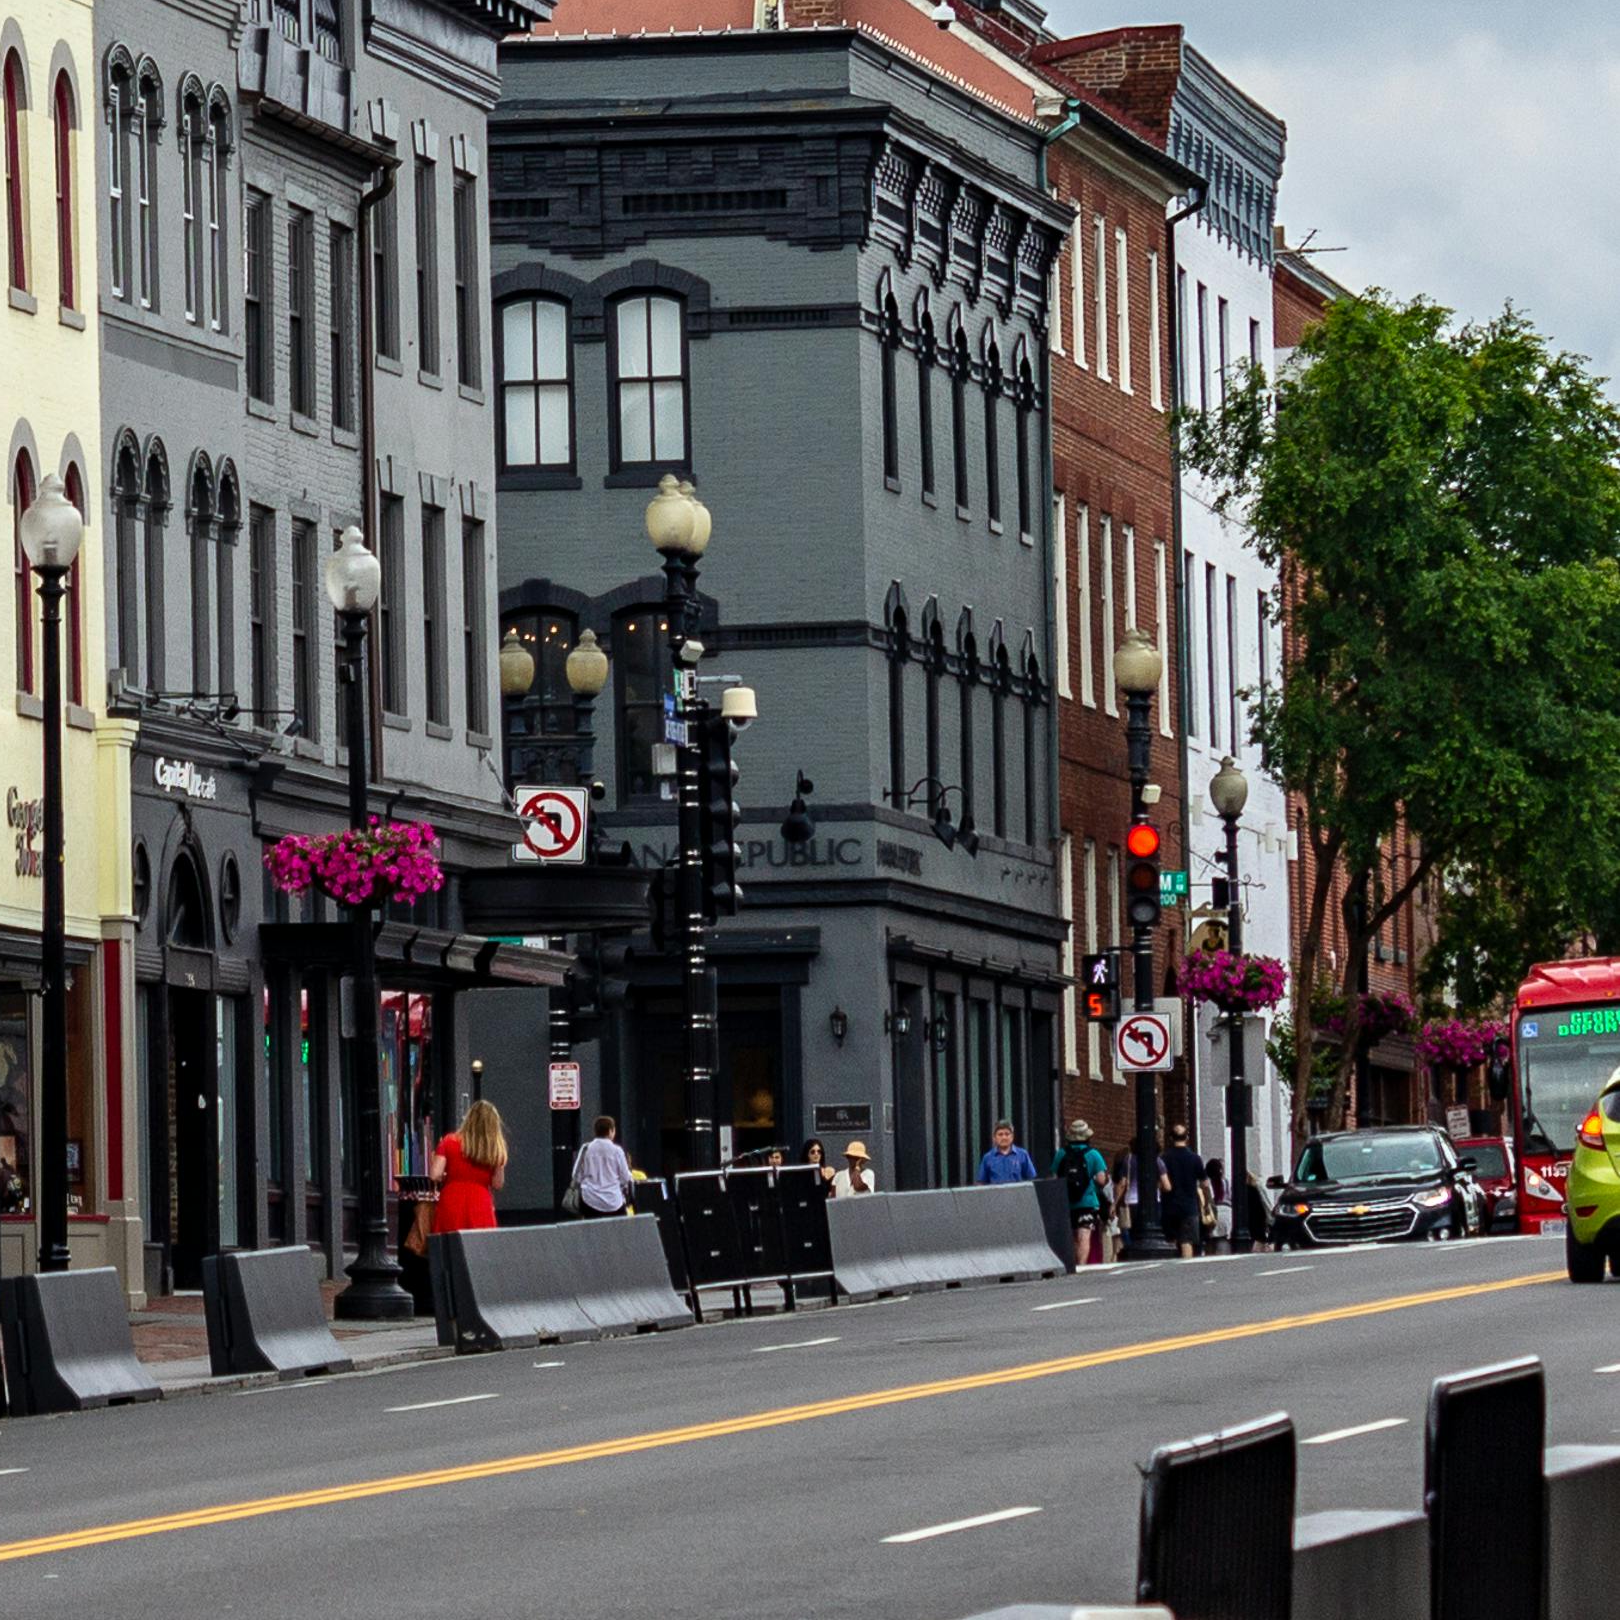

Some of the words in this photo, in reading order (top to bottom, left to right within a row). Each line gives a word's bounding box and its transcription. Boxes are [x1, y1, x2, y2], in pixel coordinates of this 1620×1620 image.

[736, 838, 862, 869] EPUBLIC
[1160, 874, 1172, 891] M
[1087, 993, 1104, 1017] 5
